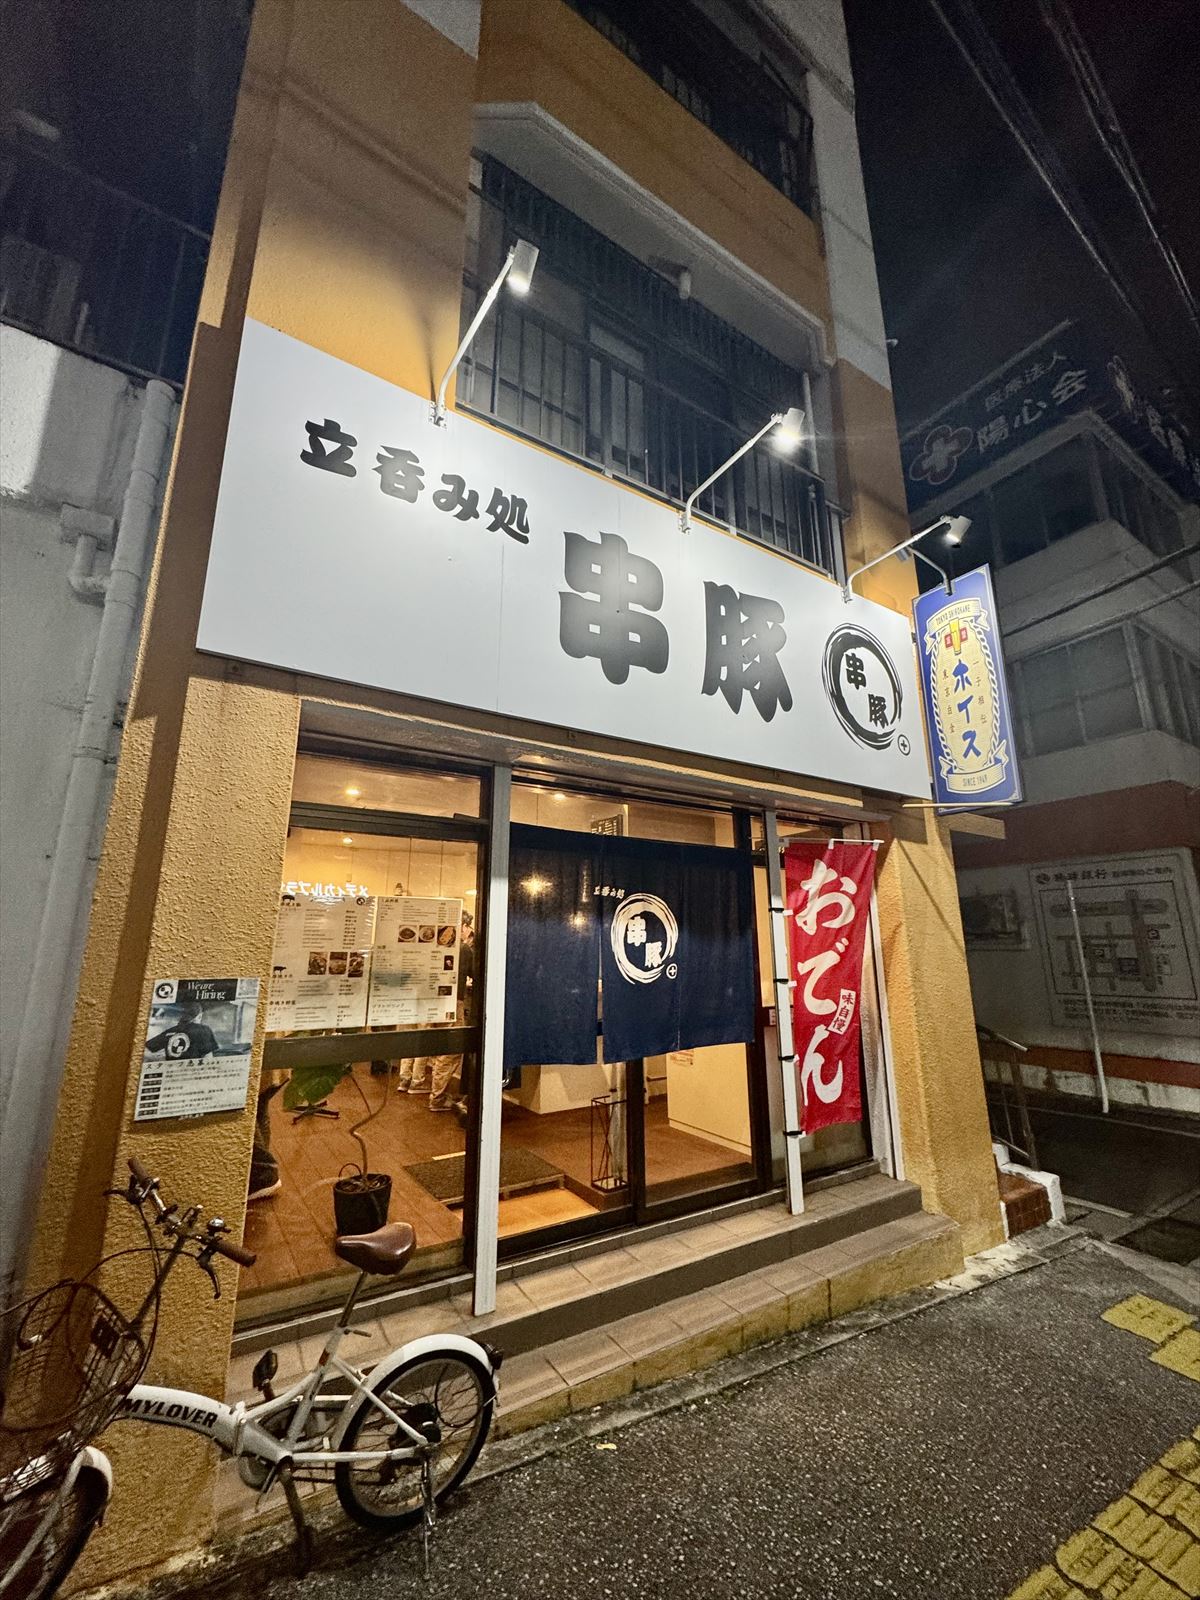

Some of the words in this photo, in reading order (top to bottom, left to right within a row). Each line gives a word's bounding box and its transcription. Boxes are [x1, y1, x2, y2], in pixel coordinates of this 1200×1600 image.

[976, 370, 1088, 453] 陽心会
[299, 418, 531, 545] 立呑み処
[558, 531, 794, 723] 串豚
[844, 652, 888, 728] 串豚
[953, 658, 981, 759] ホイス
[795, 858, 858, 1107] おでん
[123, 1397, 219, 1430] MYLOVER
